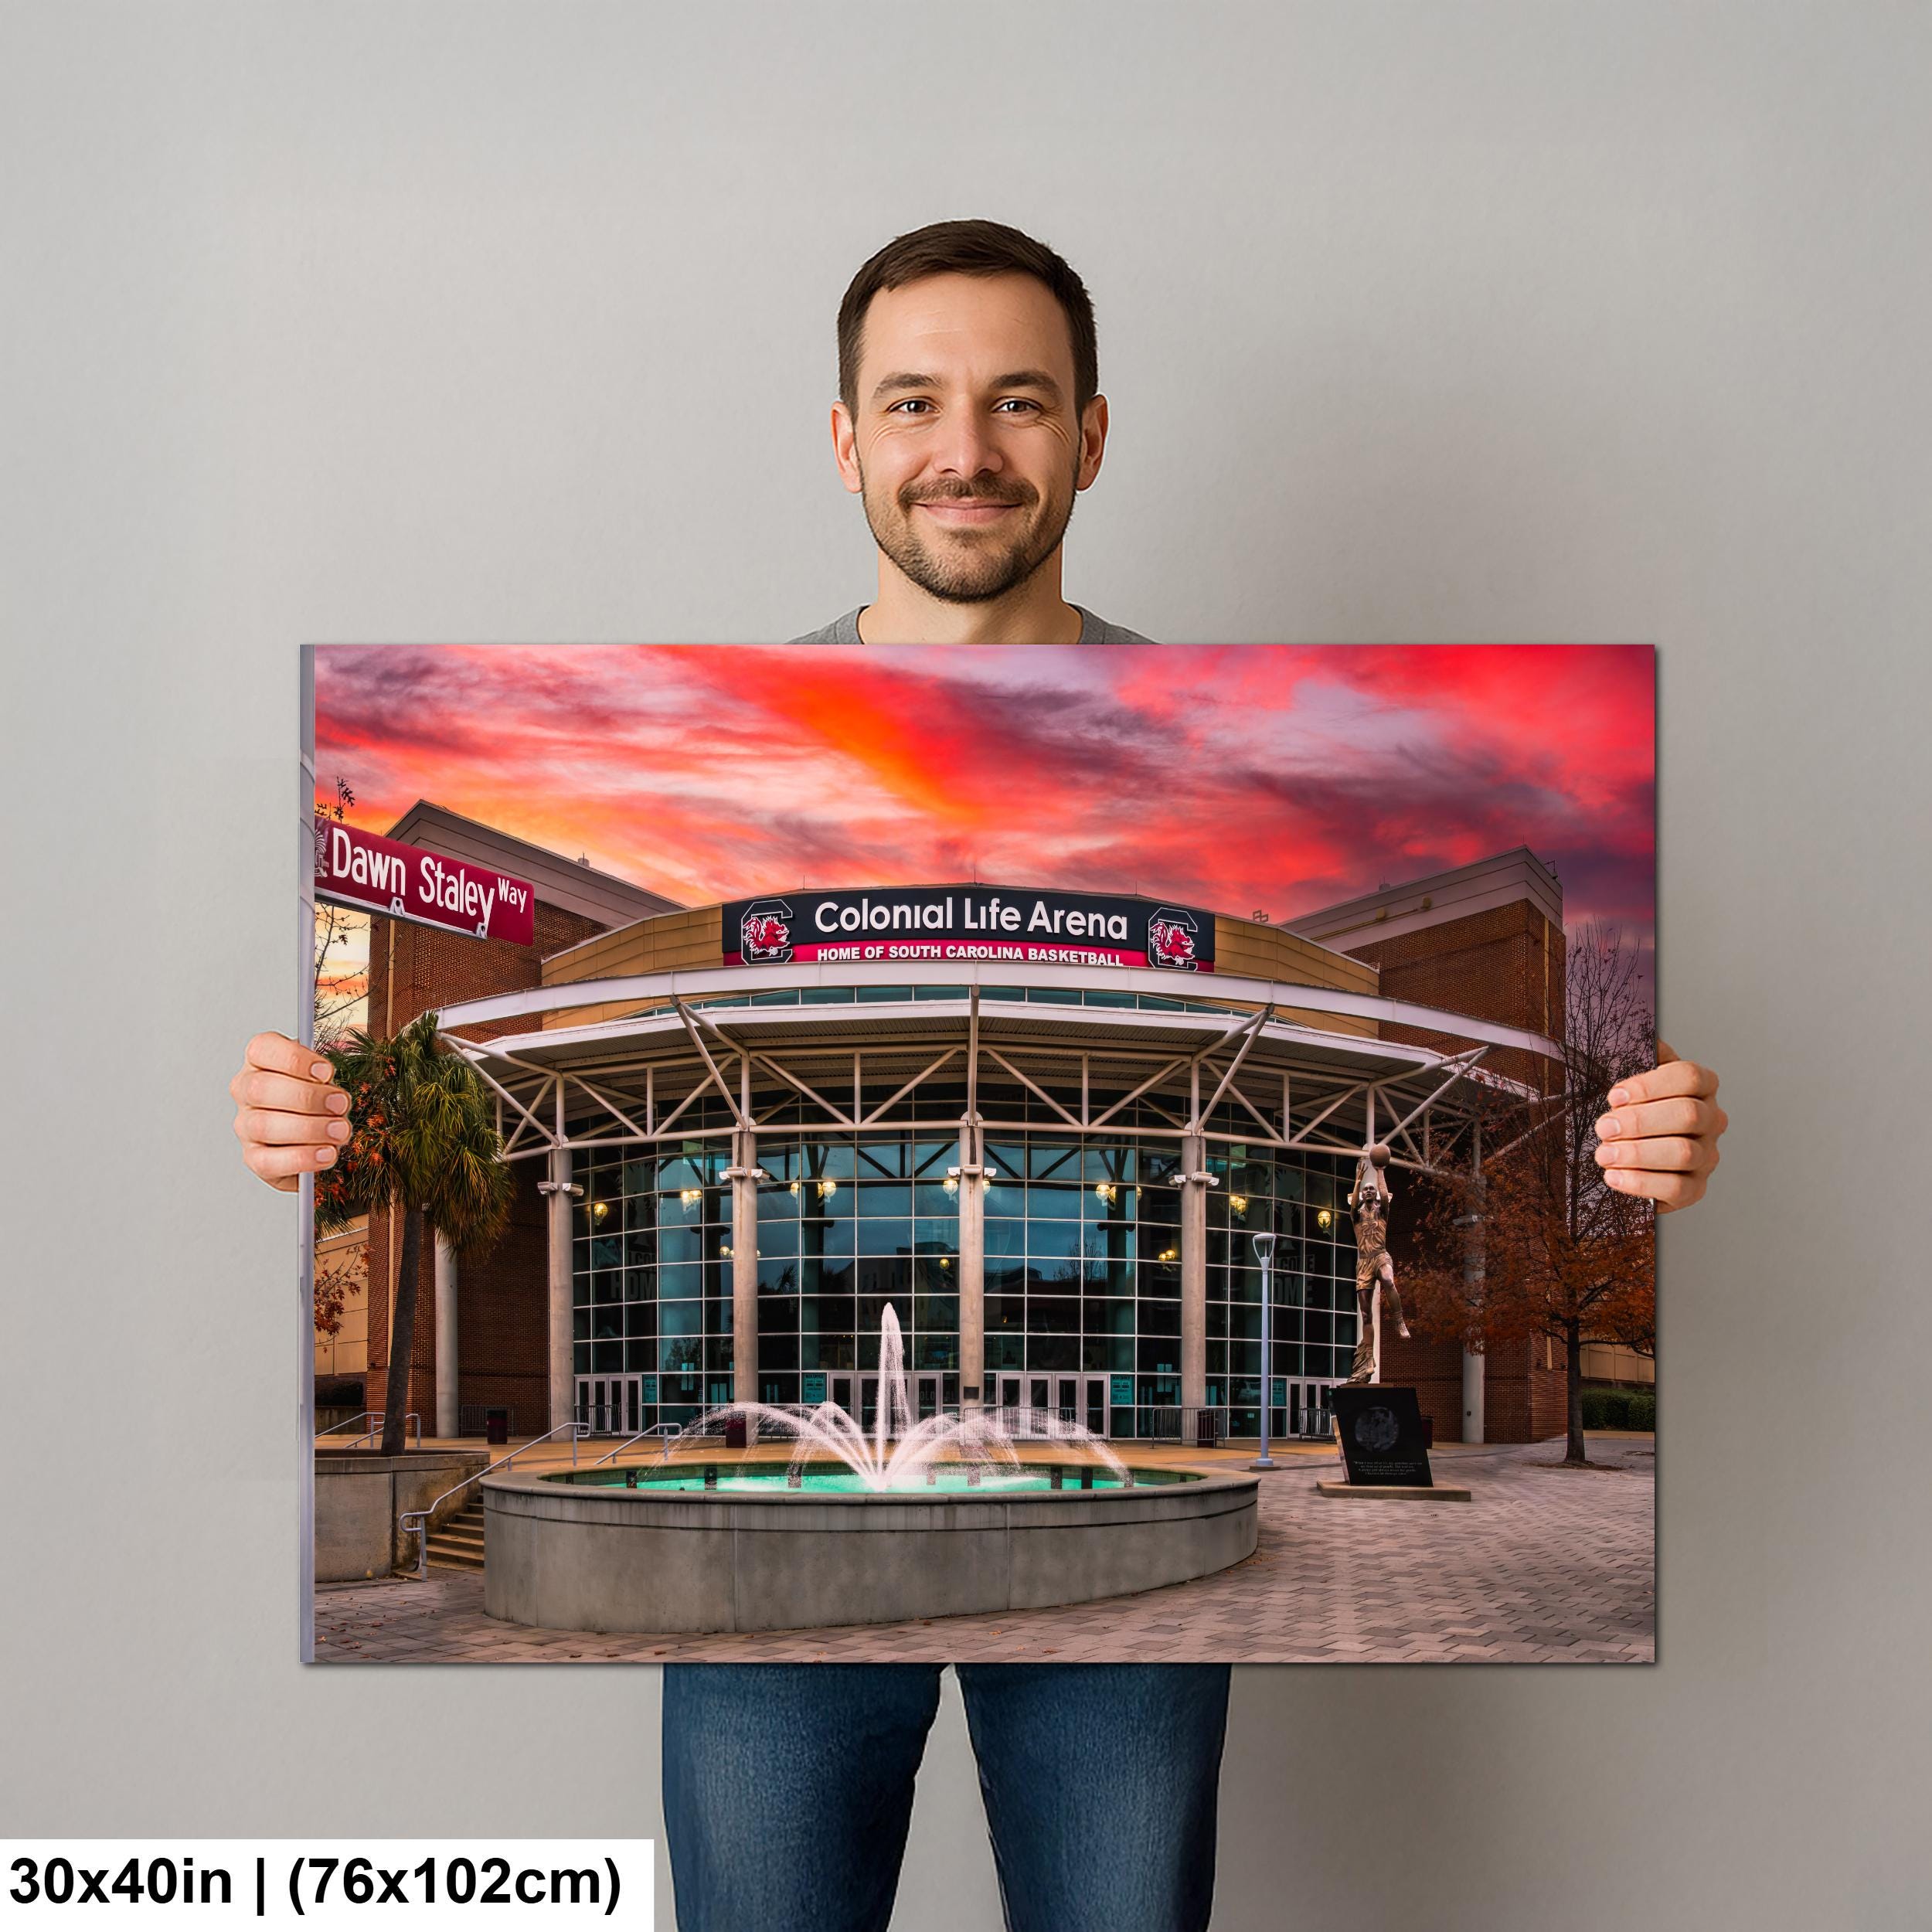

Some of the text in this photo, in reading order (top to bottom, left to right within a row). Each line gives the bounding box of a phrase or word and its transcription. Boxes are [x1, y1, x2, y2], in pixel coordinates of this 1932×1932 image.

[332, 827, 527, 930] Dawn Staley Way
[815, 896, 1128, 940] Colonial Life Arena
[817, 945, 1124, 966] HOME OF SOUTH CAROLINA BASKETBALL
